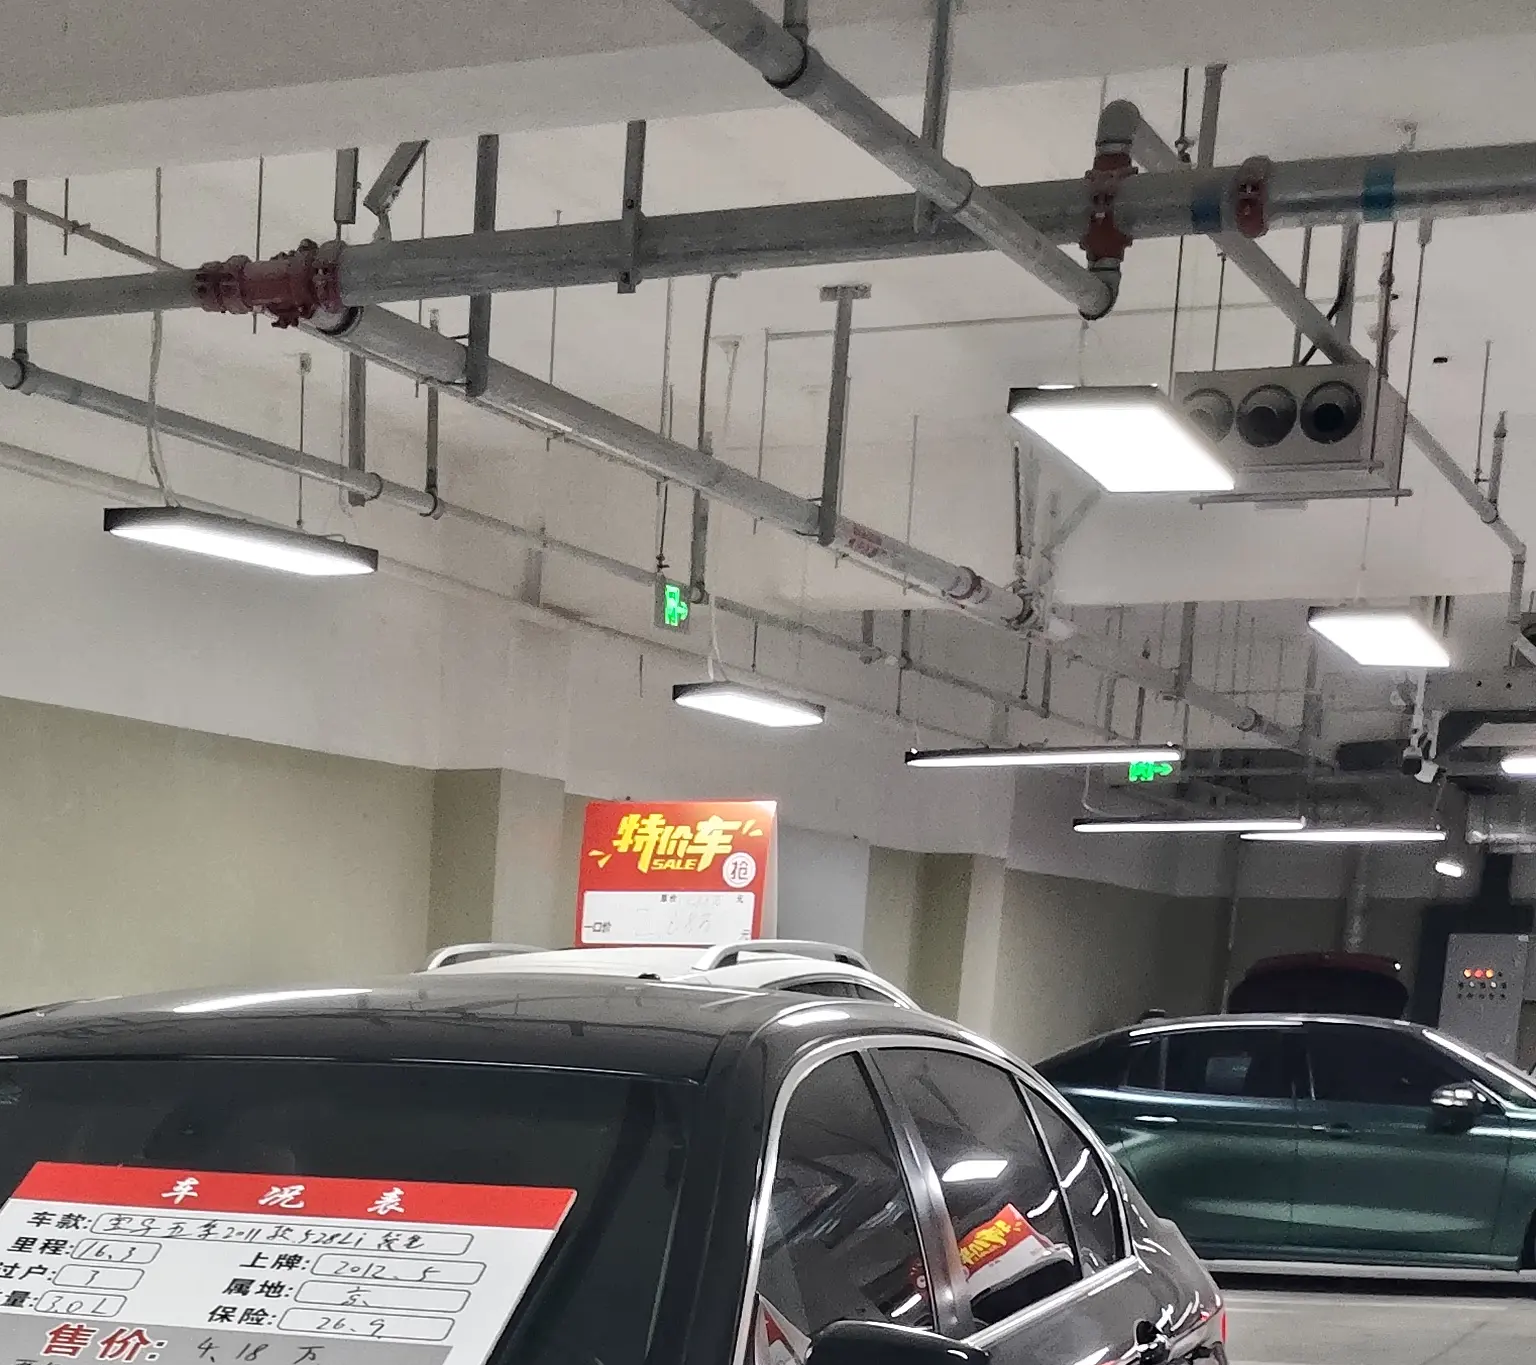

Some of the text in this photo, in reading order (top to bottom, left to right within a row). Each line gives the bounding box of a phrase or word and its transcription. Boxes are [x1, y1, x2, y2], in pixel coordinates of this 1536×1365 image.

[612, 813, 743, 873] 特价车
[651, 858, 699, 871] SALE
[161, 1176, 405, 1215] 车况表
[27, 1211, 93, 1230] 车款:
[7, 1236, 75, 1256] 里程:
[239, 1251, 312, 1271] 上牌:
[222, 1278, 295, 1299] 属地:
[207, 1304, 278, 1326] 保险:
[40, 1323, 168, 1362] 售价:
